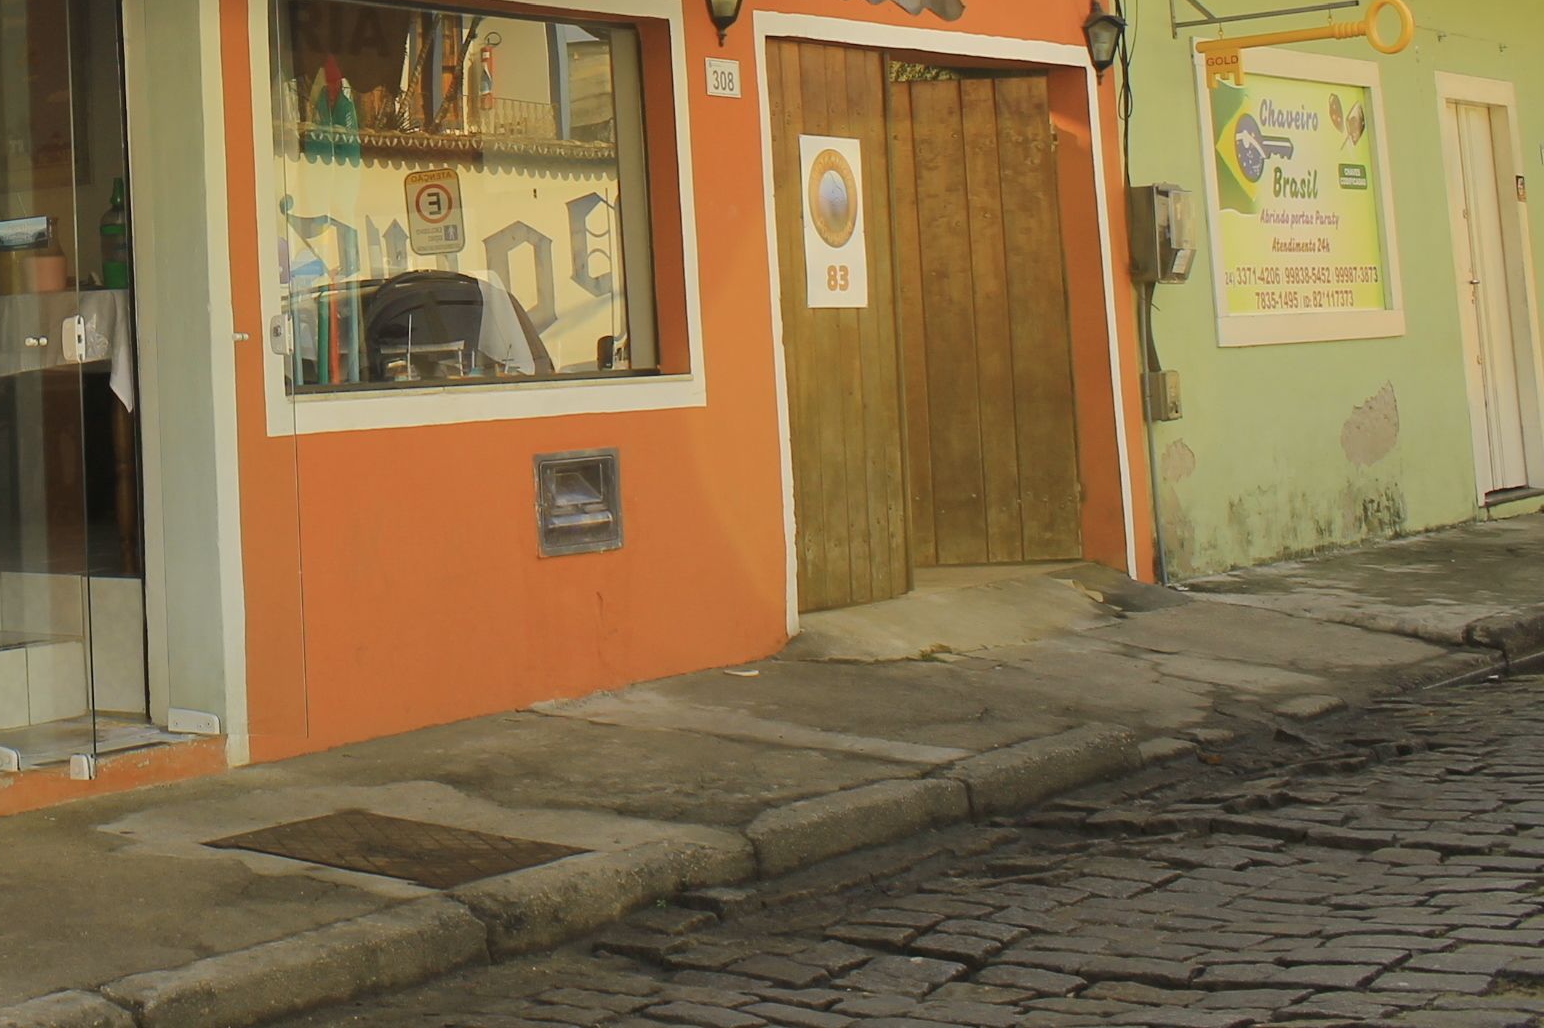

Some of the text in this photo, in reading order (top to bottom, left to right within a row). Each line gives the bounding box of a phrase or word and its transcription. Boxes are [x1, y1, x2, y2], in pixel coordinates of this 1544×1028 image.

[1206, 55, 1239, 66] GOLD
[712, 70, 735, 92] 308
[1259, 98, 1319, 132] Chaveiro
[1273, 166, 1319, 200] Brasil
[1272, 237, 1330, 253] Atendimento 24h
[827, 264, 849, 292] 83
[1236, 266, 1281, 285] 3371-4206
[1285, 266, 1332, 285] 99838-5452
[1334, 265, 1378, 284] 99987-3873
[1255, 290, 1298, 309] 7835-1495
